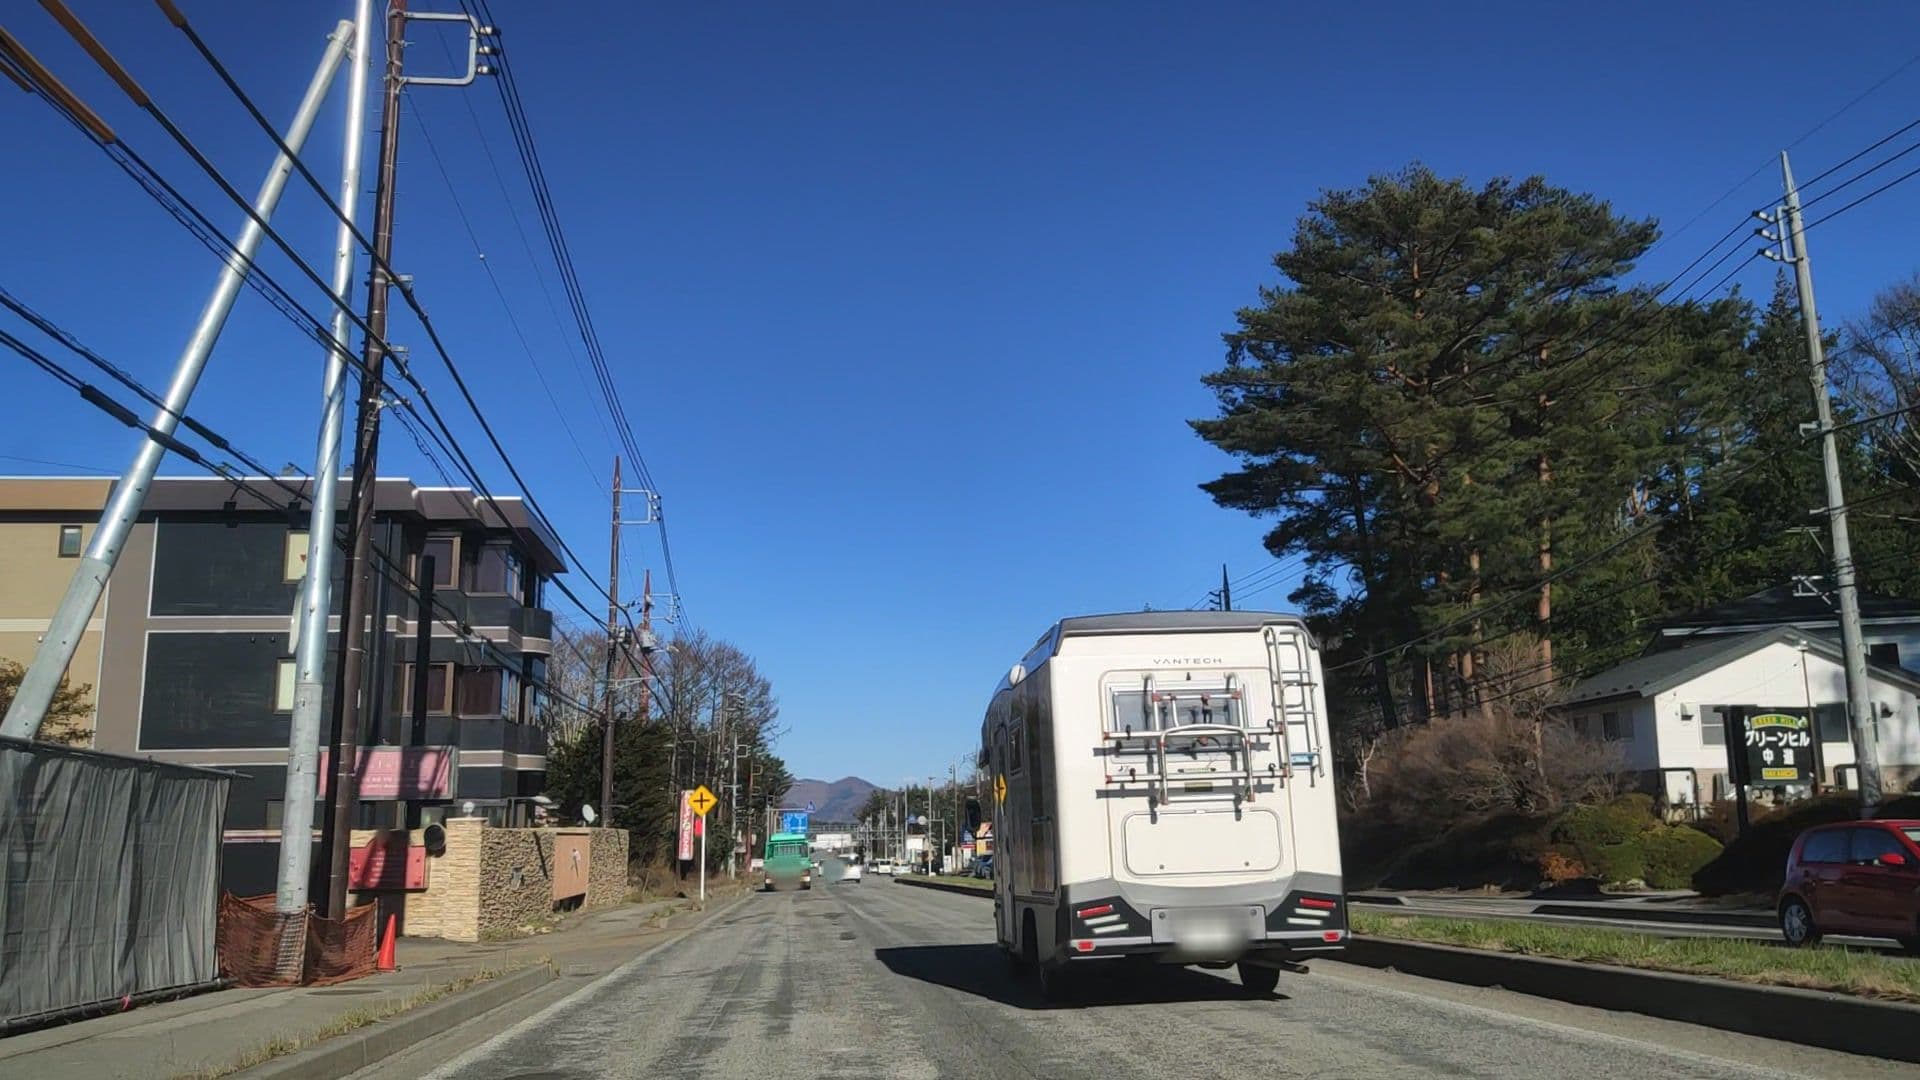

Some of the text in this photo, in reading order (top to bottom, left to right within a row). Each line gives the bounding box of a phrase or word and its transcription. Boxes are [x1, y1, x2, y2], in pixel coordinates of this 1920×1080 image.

[1745, 729, 1810, 747] グリーンヒル
